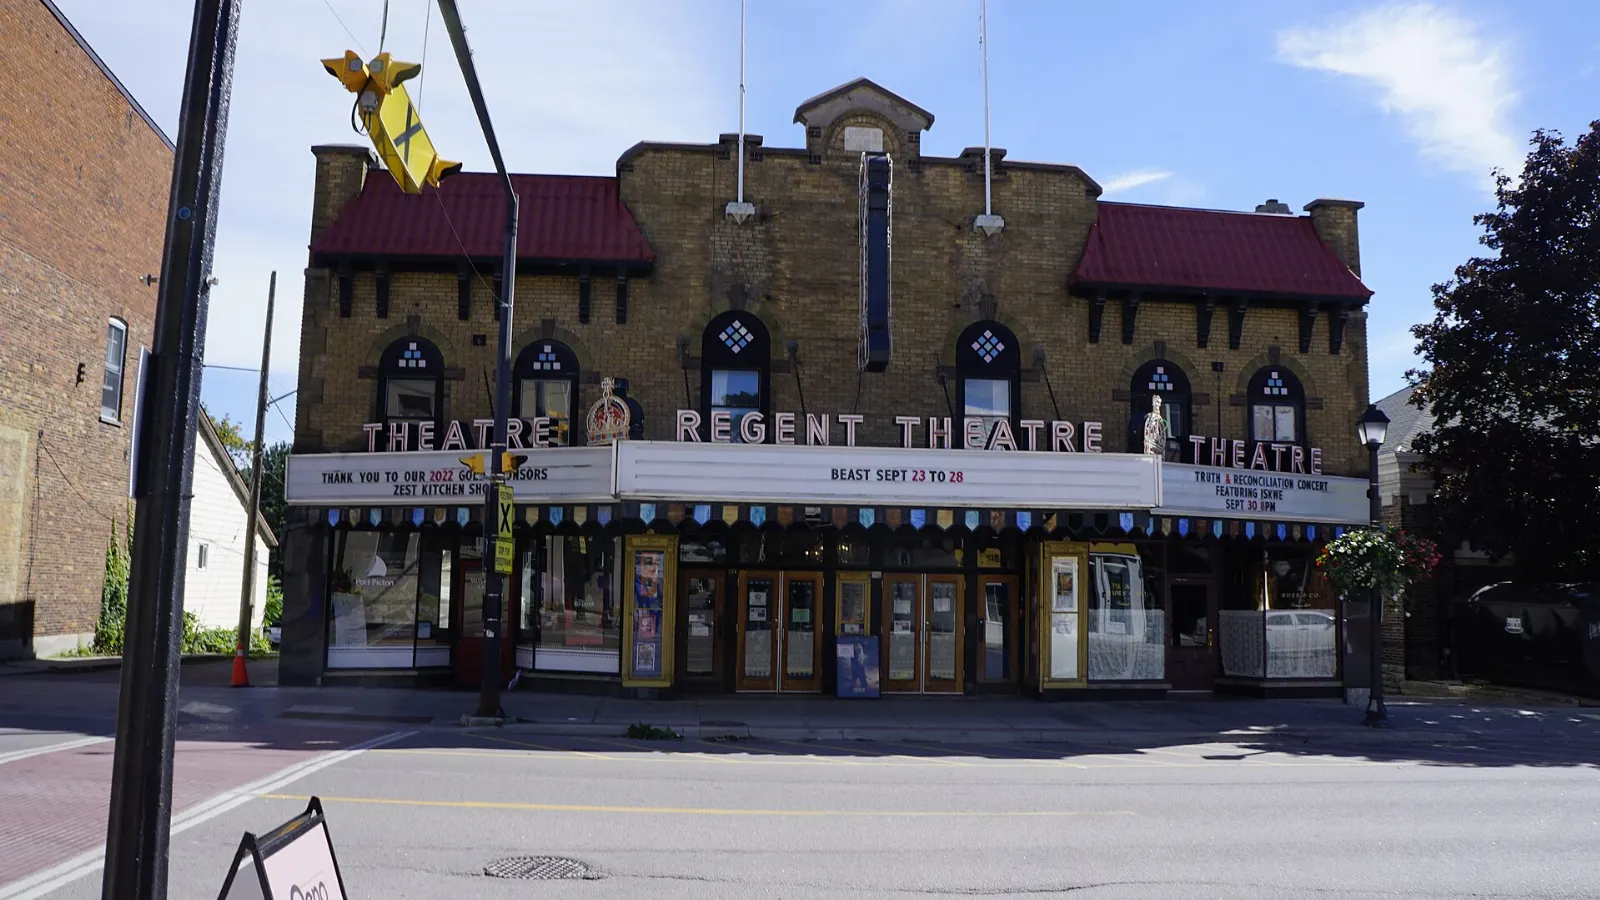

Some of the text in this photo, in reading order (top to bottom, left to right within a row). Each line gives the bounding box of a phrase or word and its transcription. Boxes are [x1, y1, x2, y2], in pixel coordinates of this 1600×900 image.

[363, 416, 550, 452] THEATRE
[676, 409, 1103, 453] REGENT THEATRE
[1189, 434, 1322, 475] THEATRE
[322, 468, 548, 484] THANK YOU TO OUR 2022 GOL NSORS
[831, 468, 964, 483] BEAST SEPT 23 TO 28
[1195, 471, 1328, 492] TRUTH & RECONCILIATION CONCERT
[394, 483, 491, 496] ZEST KITCHEN SHO
[1216, 486, 1284, 500] FEATURING ISKWE
[1226, 499, 1244, 510] SEPT
[1248, 500, 1258, 511] 30
[500, 503, 511, 533] X
[355, 578, 394, 586] Port Picton
